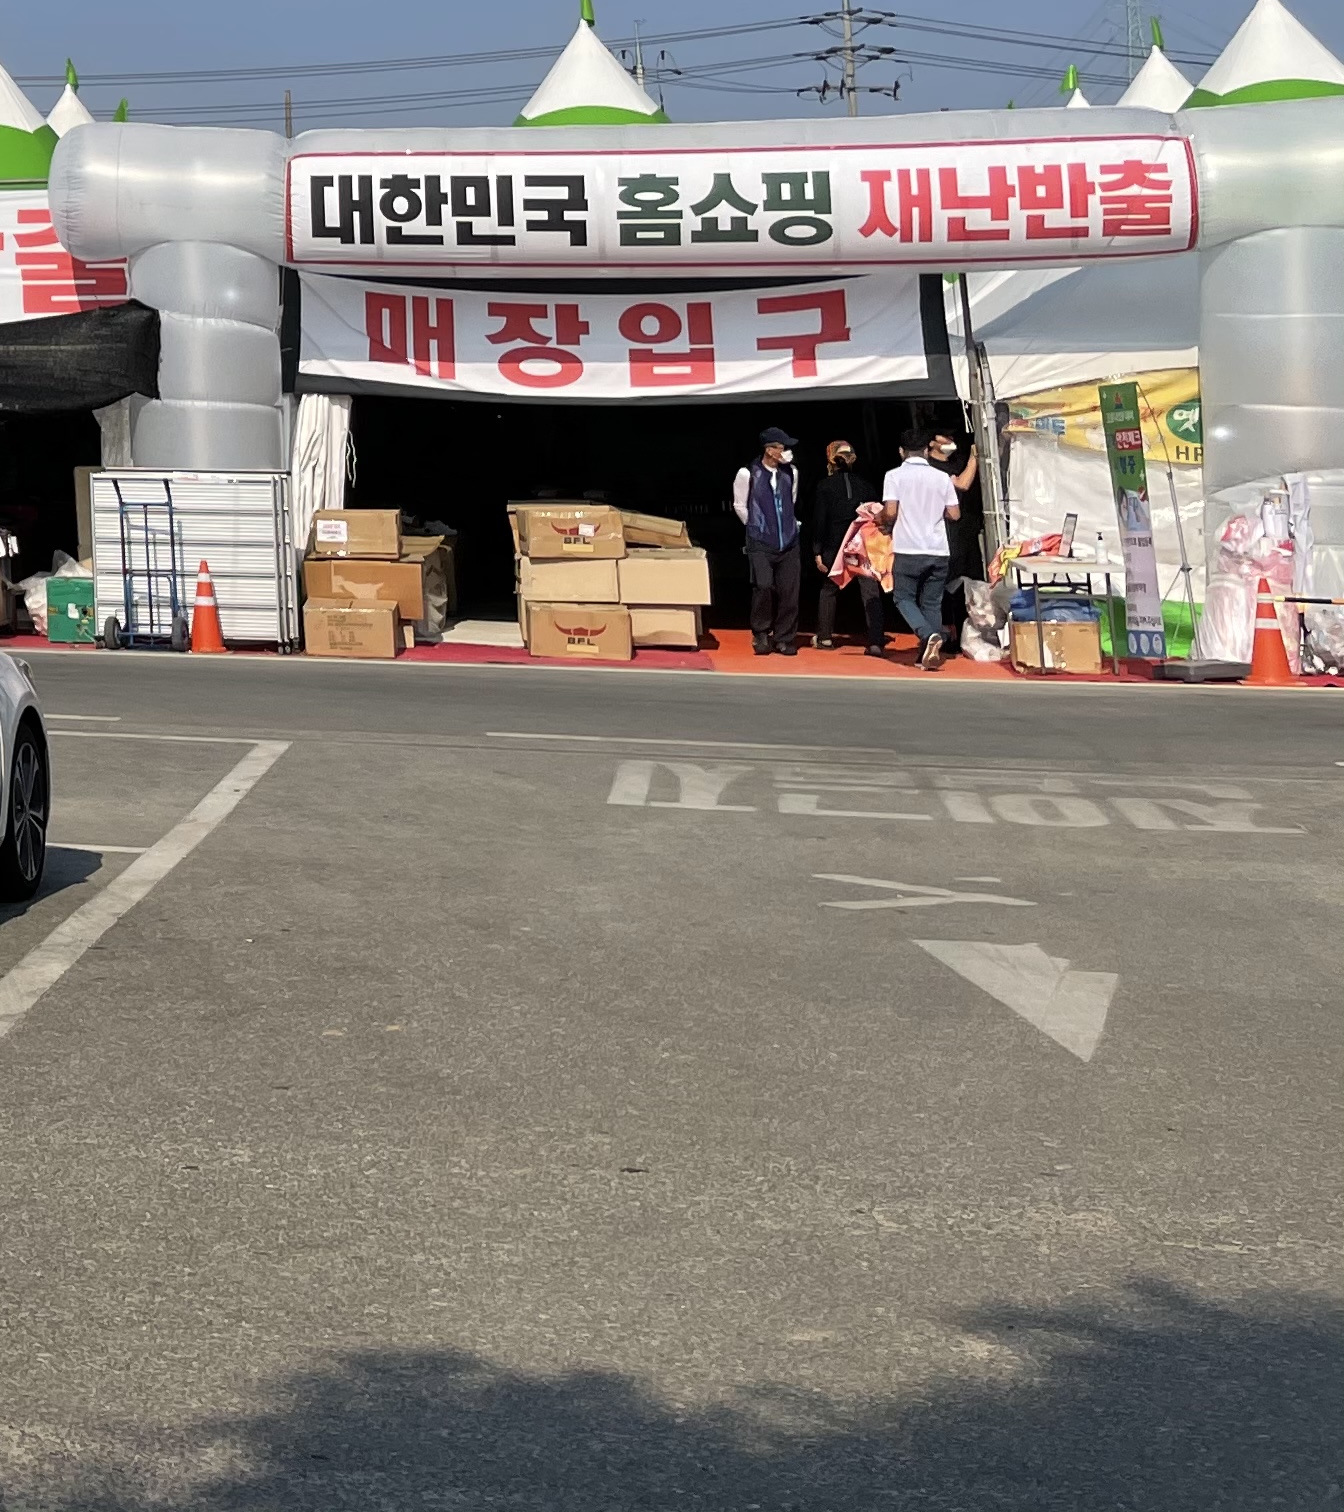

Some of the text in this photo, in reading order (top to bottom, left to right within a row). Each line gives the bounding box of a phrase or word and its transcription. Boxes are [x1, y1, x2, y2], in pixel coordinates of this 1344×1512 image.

[310, 159, 1173, 246] 대한민국 홈쇼핑 재난반출
[563, 536, 591, 545] BFL
[567, 637, 596, 645] BFL
